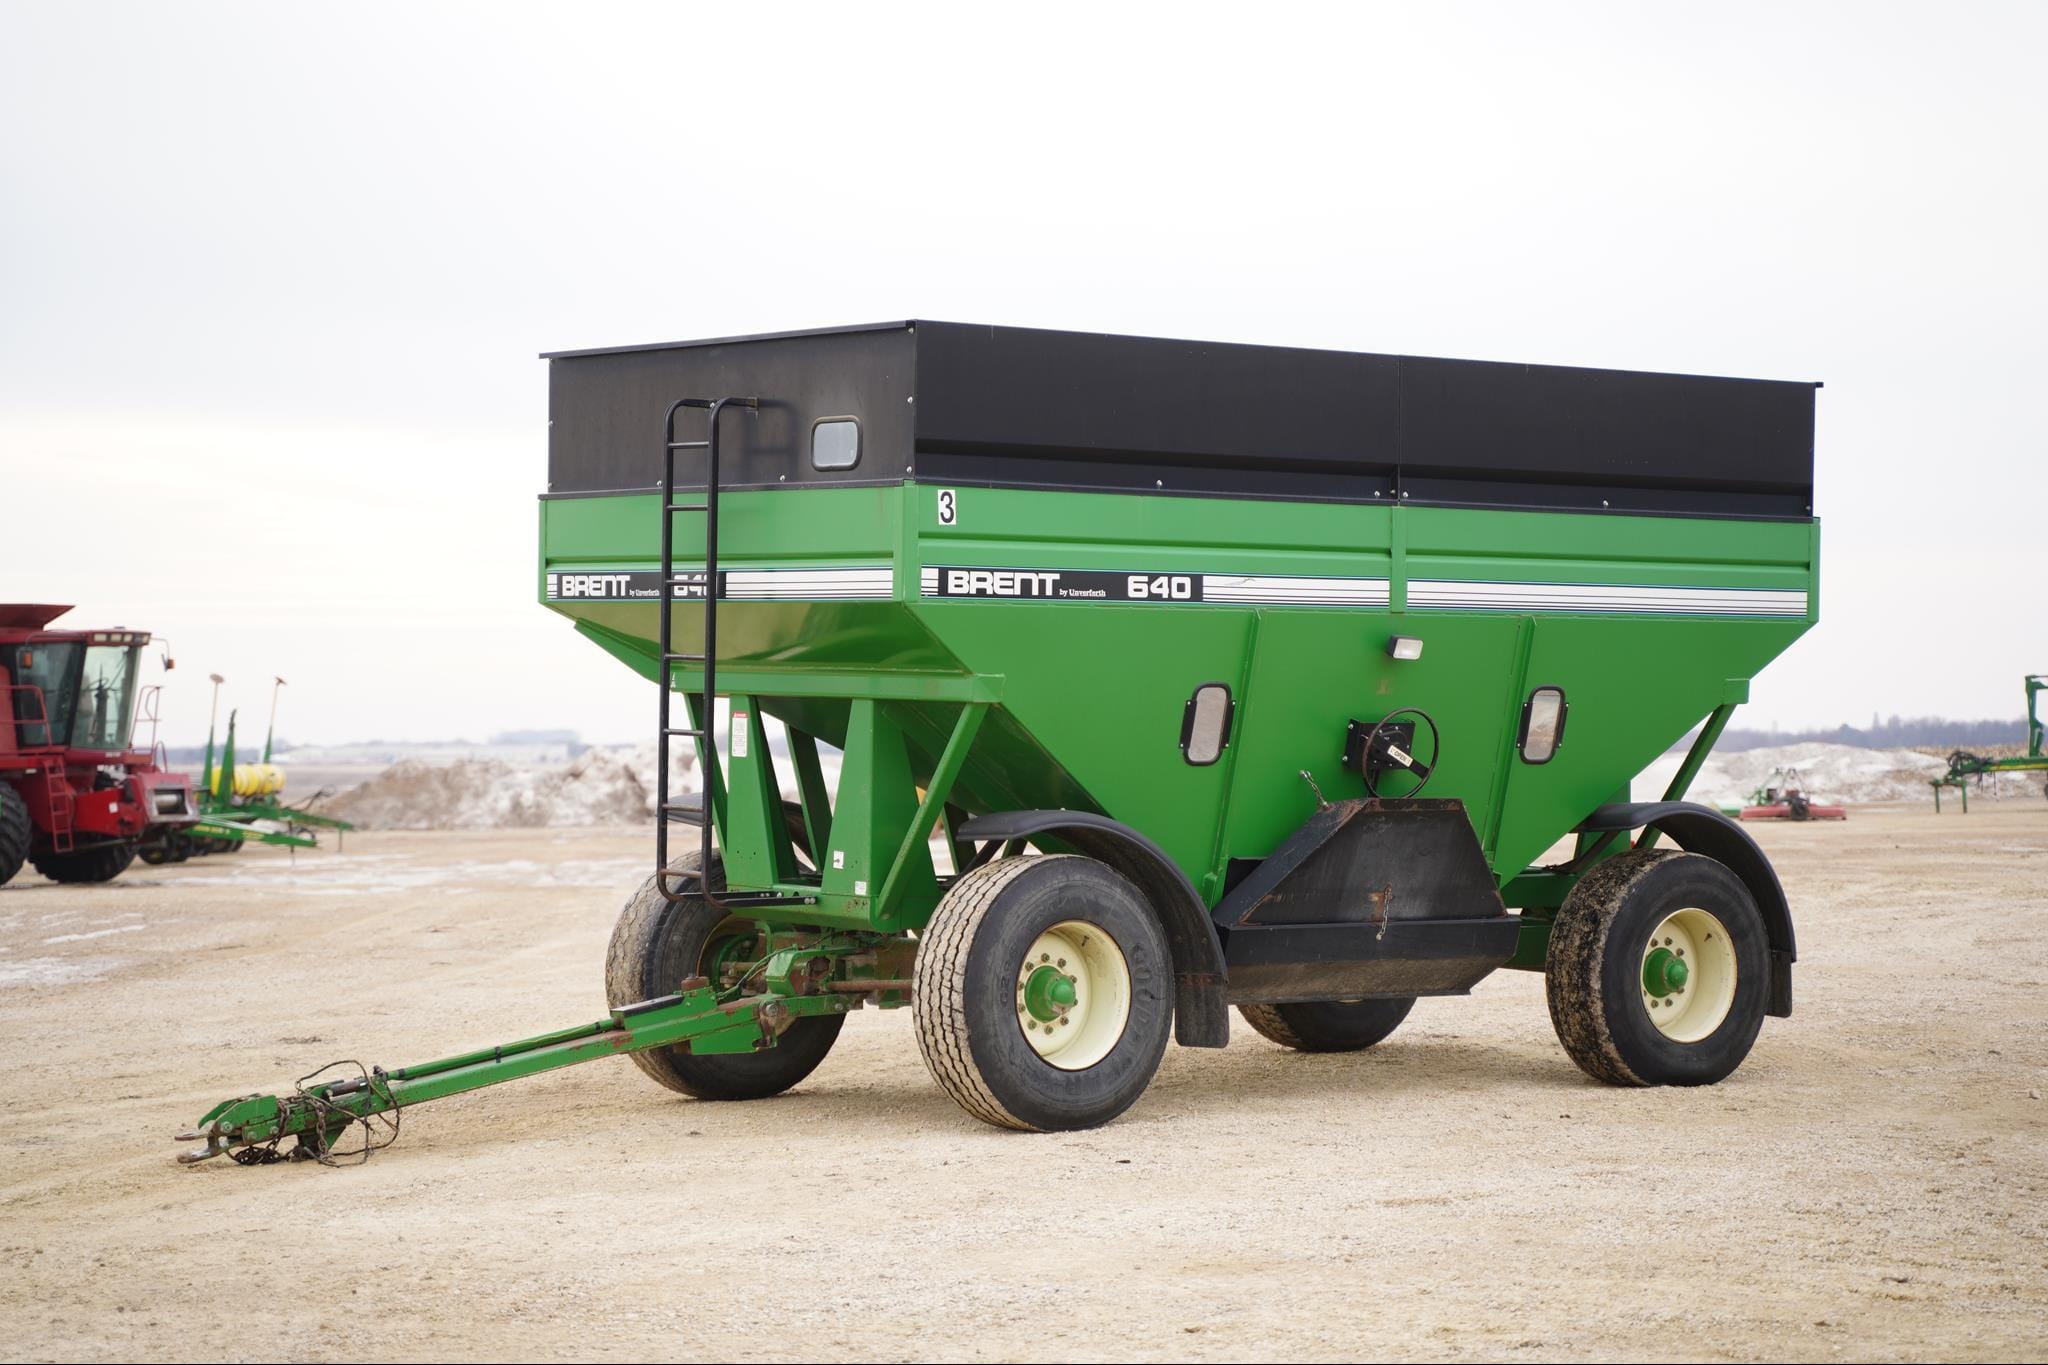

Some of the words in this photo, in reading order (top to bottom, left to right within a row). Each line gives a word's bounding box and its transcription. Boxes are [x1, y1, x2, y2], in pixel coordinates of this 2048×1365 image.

[940, 491, 955, 524] 3
[562, 575, 631, 597] BRENT
[948, 571, 1061, 597] BRENT
[1059, 588, 1068, 598] by
[1069, 588, 1107, 598] Unverferth
[1127, 575, 1192, 599] 640
